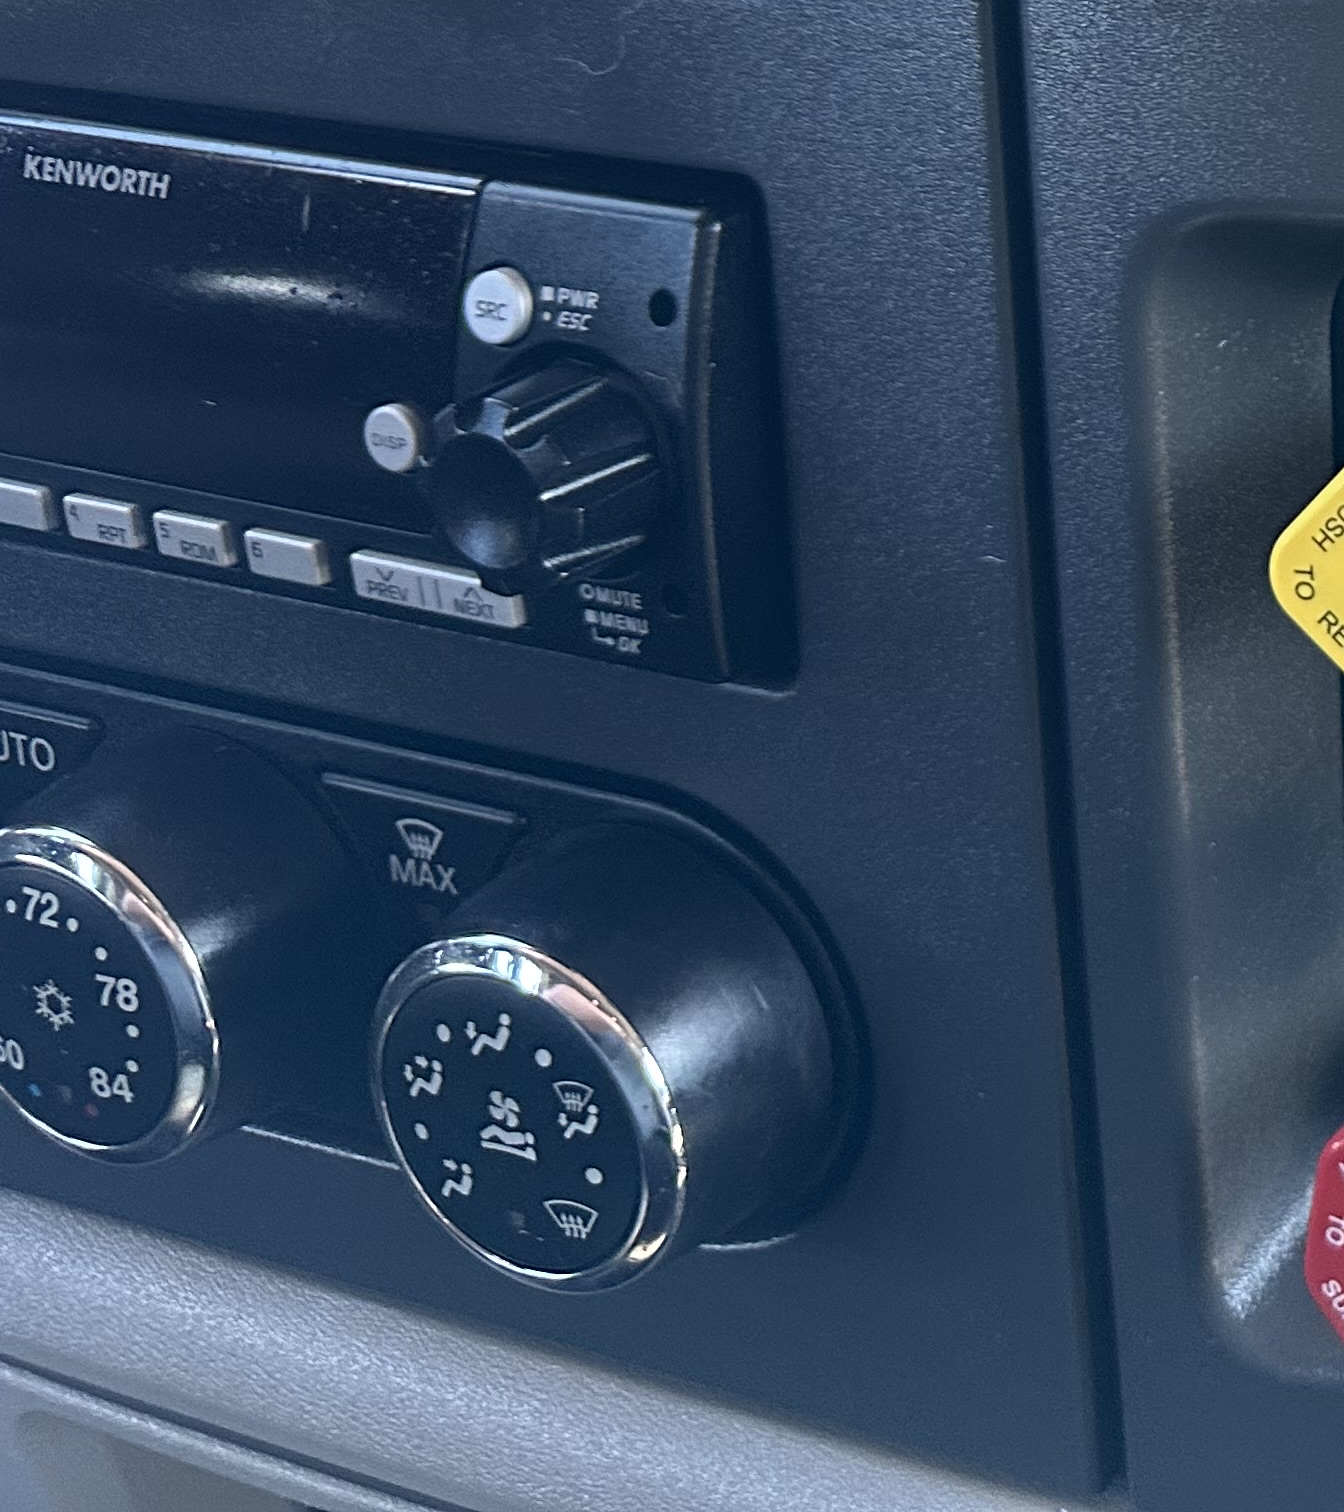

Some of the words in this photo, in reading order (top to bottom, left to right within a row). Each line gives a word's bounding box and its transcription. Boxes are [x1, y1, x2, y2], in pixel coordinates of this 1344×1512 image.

[23, 153, 171, 199] KENWORTH
[474, 298, 508, 321] SRC
[556, 287, 600, 310] PWR
[557, 310, 593, 331] ESC
[371, 432, 407, 450] DISP
[96, 523, 127, 545] RPT
[158, 521, 170, 540] 5
[179, 539, 217, 562] RDM
[251, 541, 264, 558] 6
[366, 580, 408, 603] PREV
[1293, 564, 1316, 601] TO
[453, 597, 496, 621] NEXT
[598, 587, 643, 610] MUTE
[600, 611, 649, 635] MENU
[616, 636, 642, 655] OK
[388, 854, 459, 896] MAX
[22, 888, 60, 928] 72
[95, 974, 139, 1013] 78
[88, 1067, 135, 1104] 84
